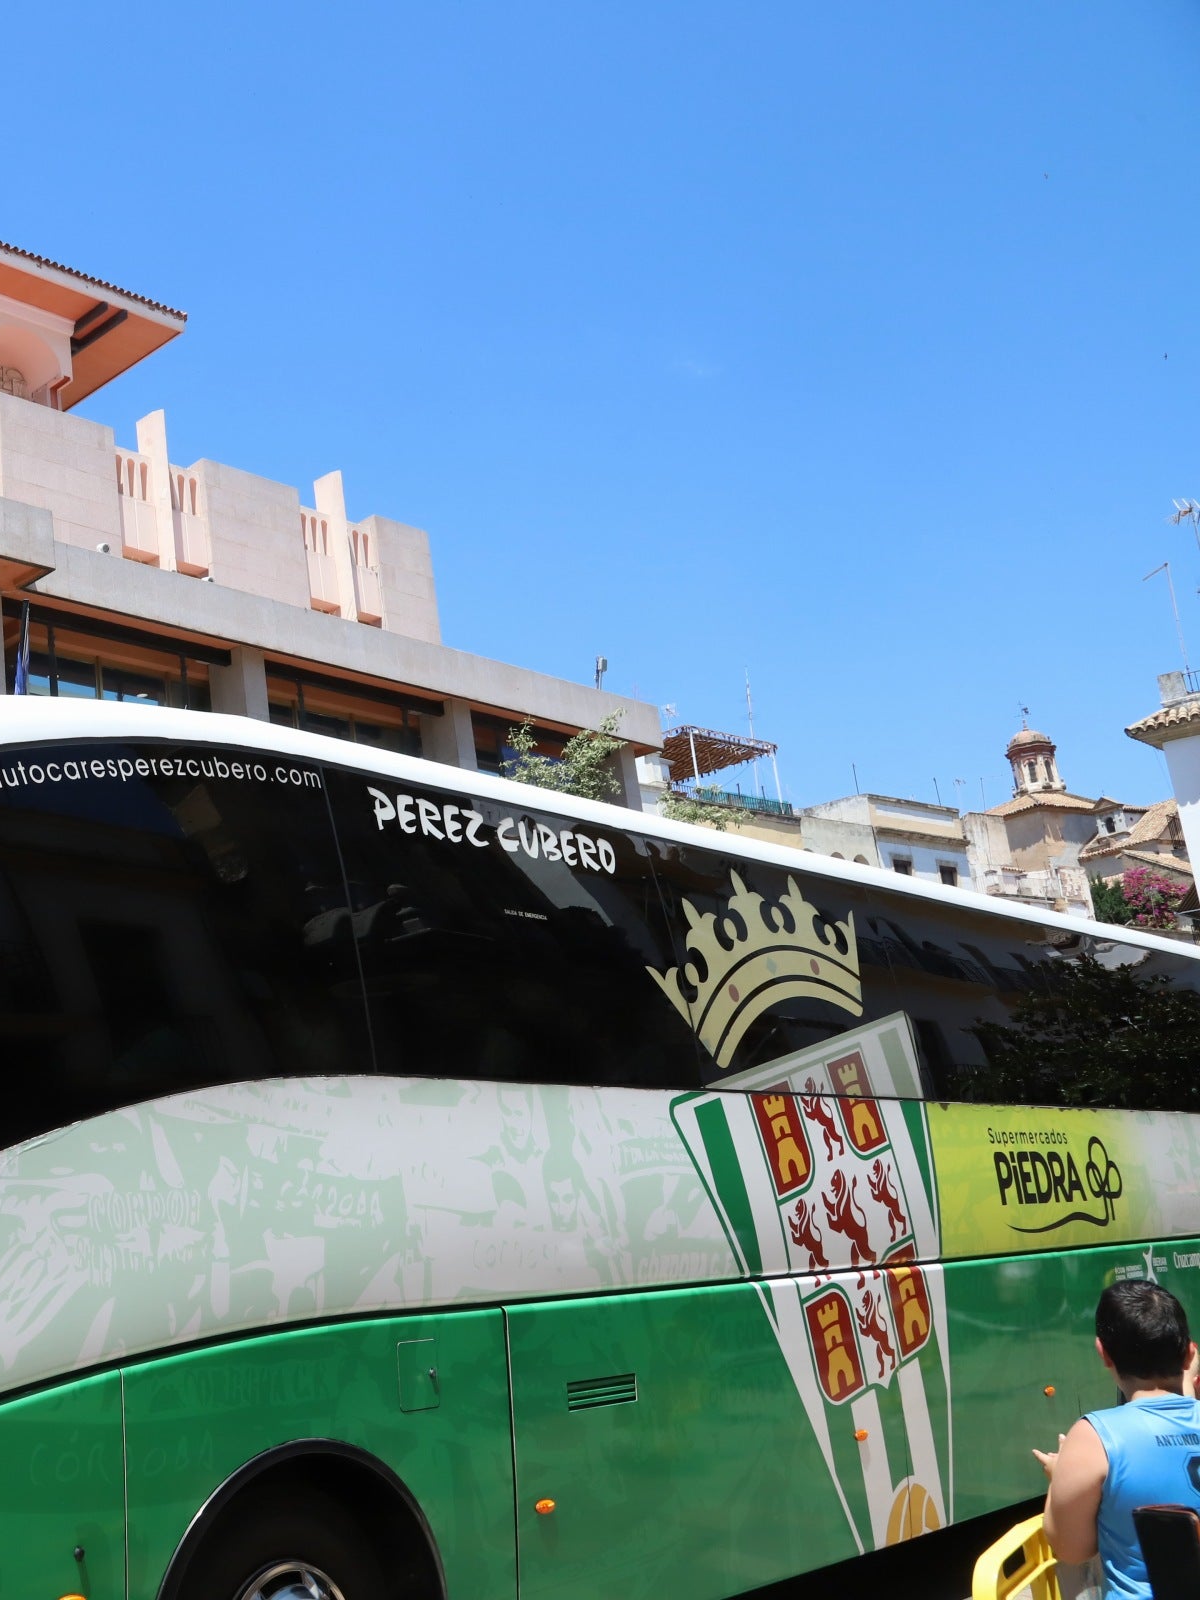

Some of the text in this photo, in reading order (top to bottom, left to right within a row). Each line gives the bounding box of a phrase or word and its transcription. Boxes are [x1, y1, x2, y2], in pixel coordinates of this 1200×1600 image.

[367, 786, 617, 875] PEREZ CUBERO
[987, 1127, 1069, 1147] Supermercados
[1155, 1433, 1200, 1448] ANTONIO
